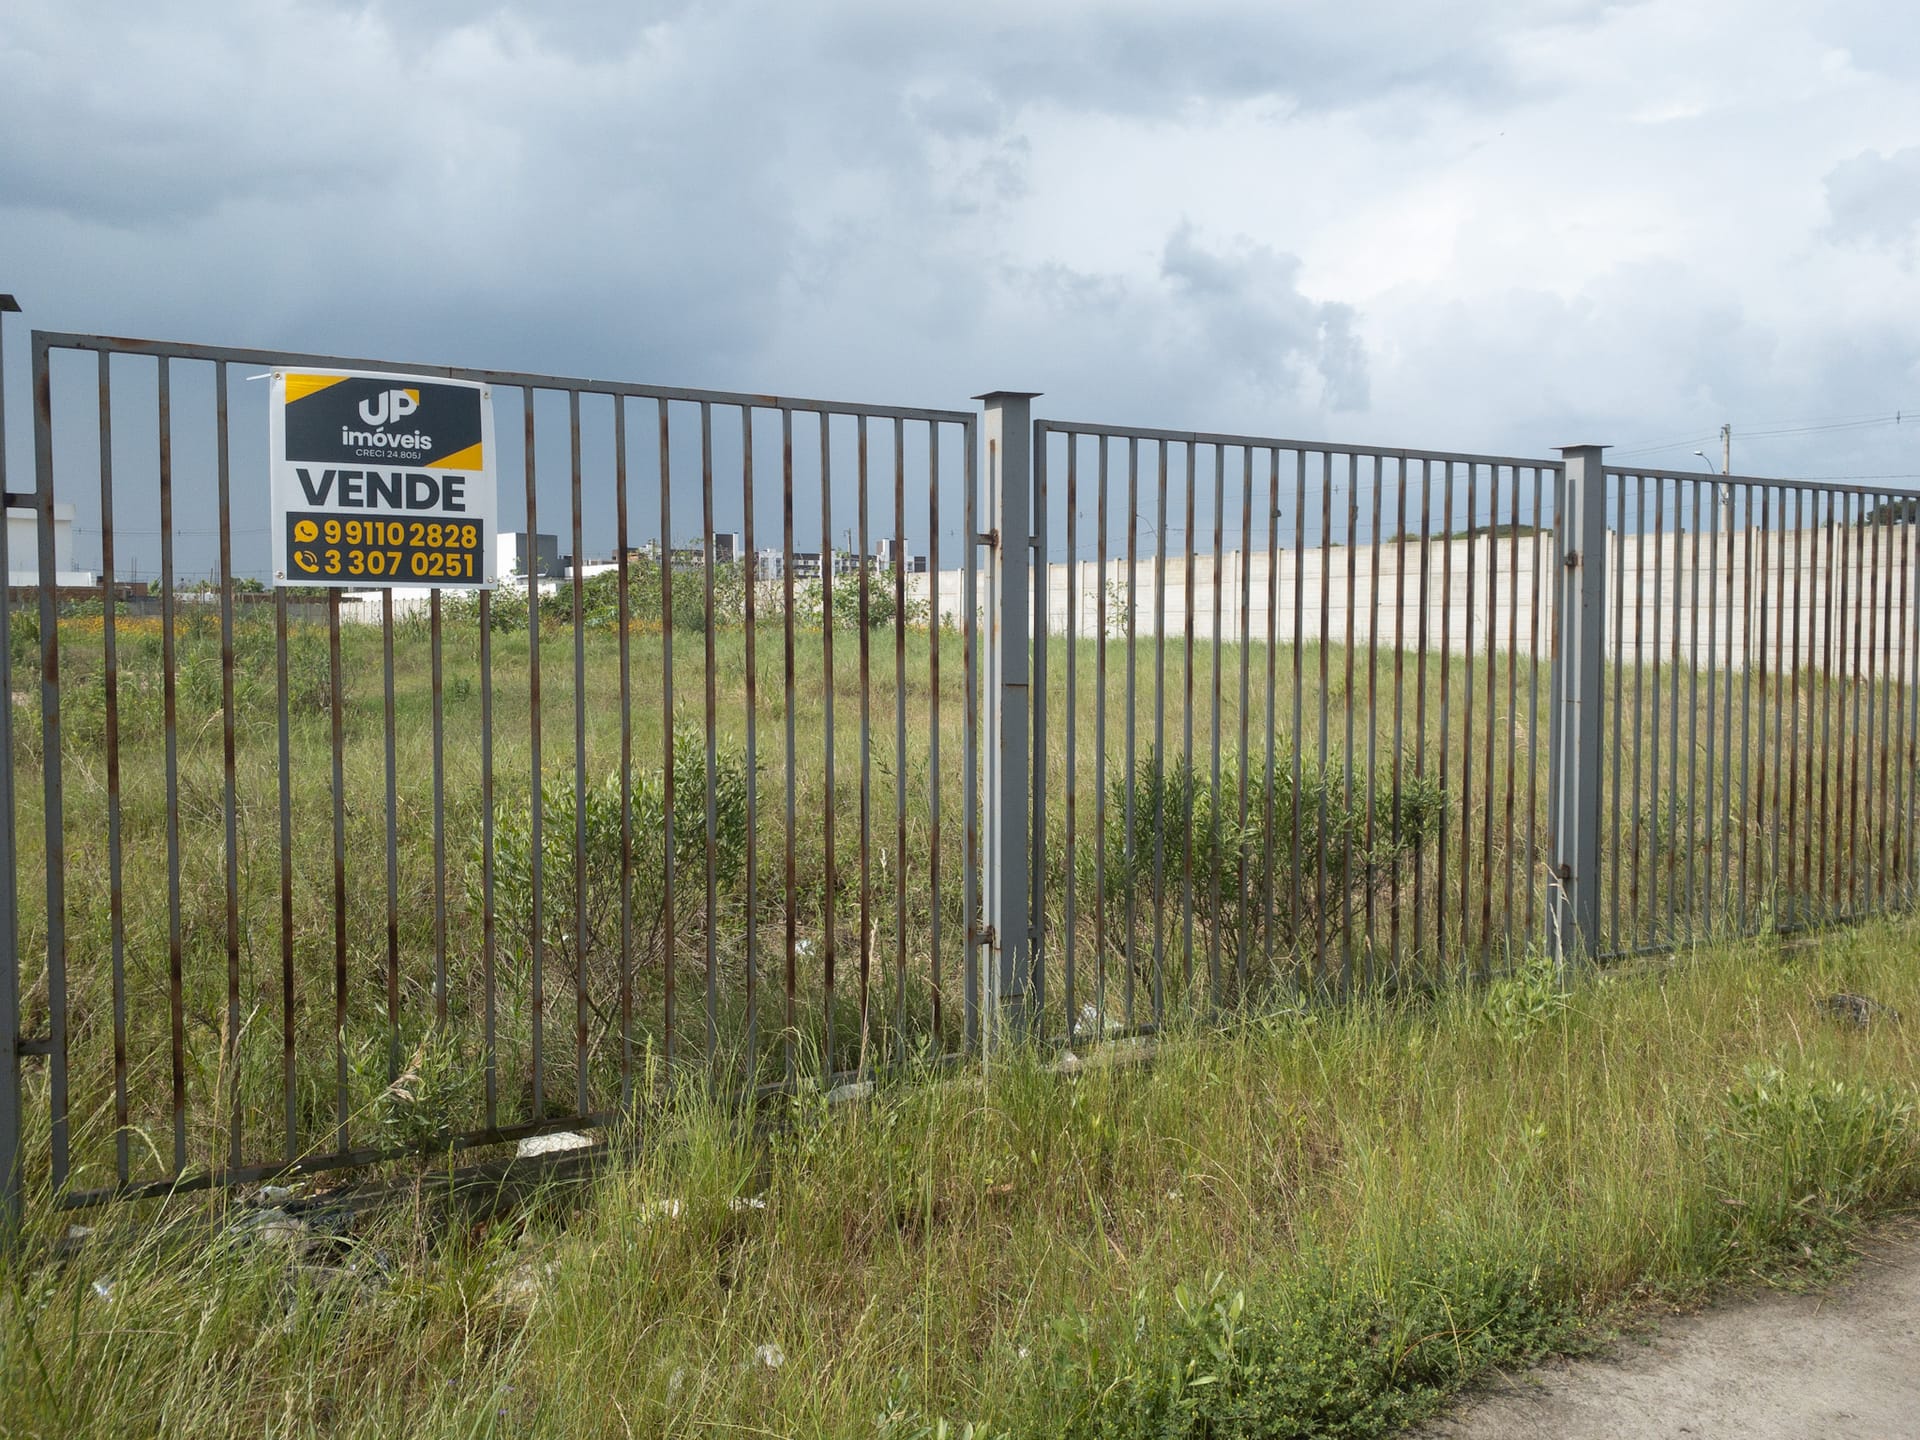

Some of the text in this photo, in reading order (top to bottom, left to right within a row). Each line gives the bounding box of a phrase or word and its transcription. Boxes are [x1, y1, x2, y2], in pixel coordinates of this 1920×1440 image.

[359, 389, 420, 426] UP
[342, 426, 432, 450] imóveis
[356, 449, 384, 457] CRECI
[296, 468, 465, 512] VENDE
[409, 523, 477, 548] 2828
[324, 549, 473, 576] 3 307 0251
